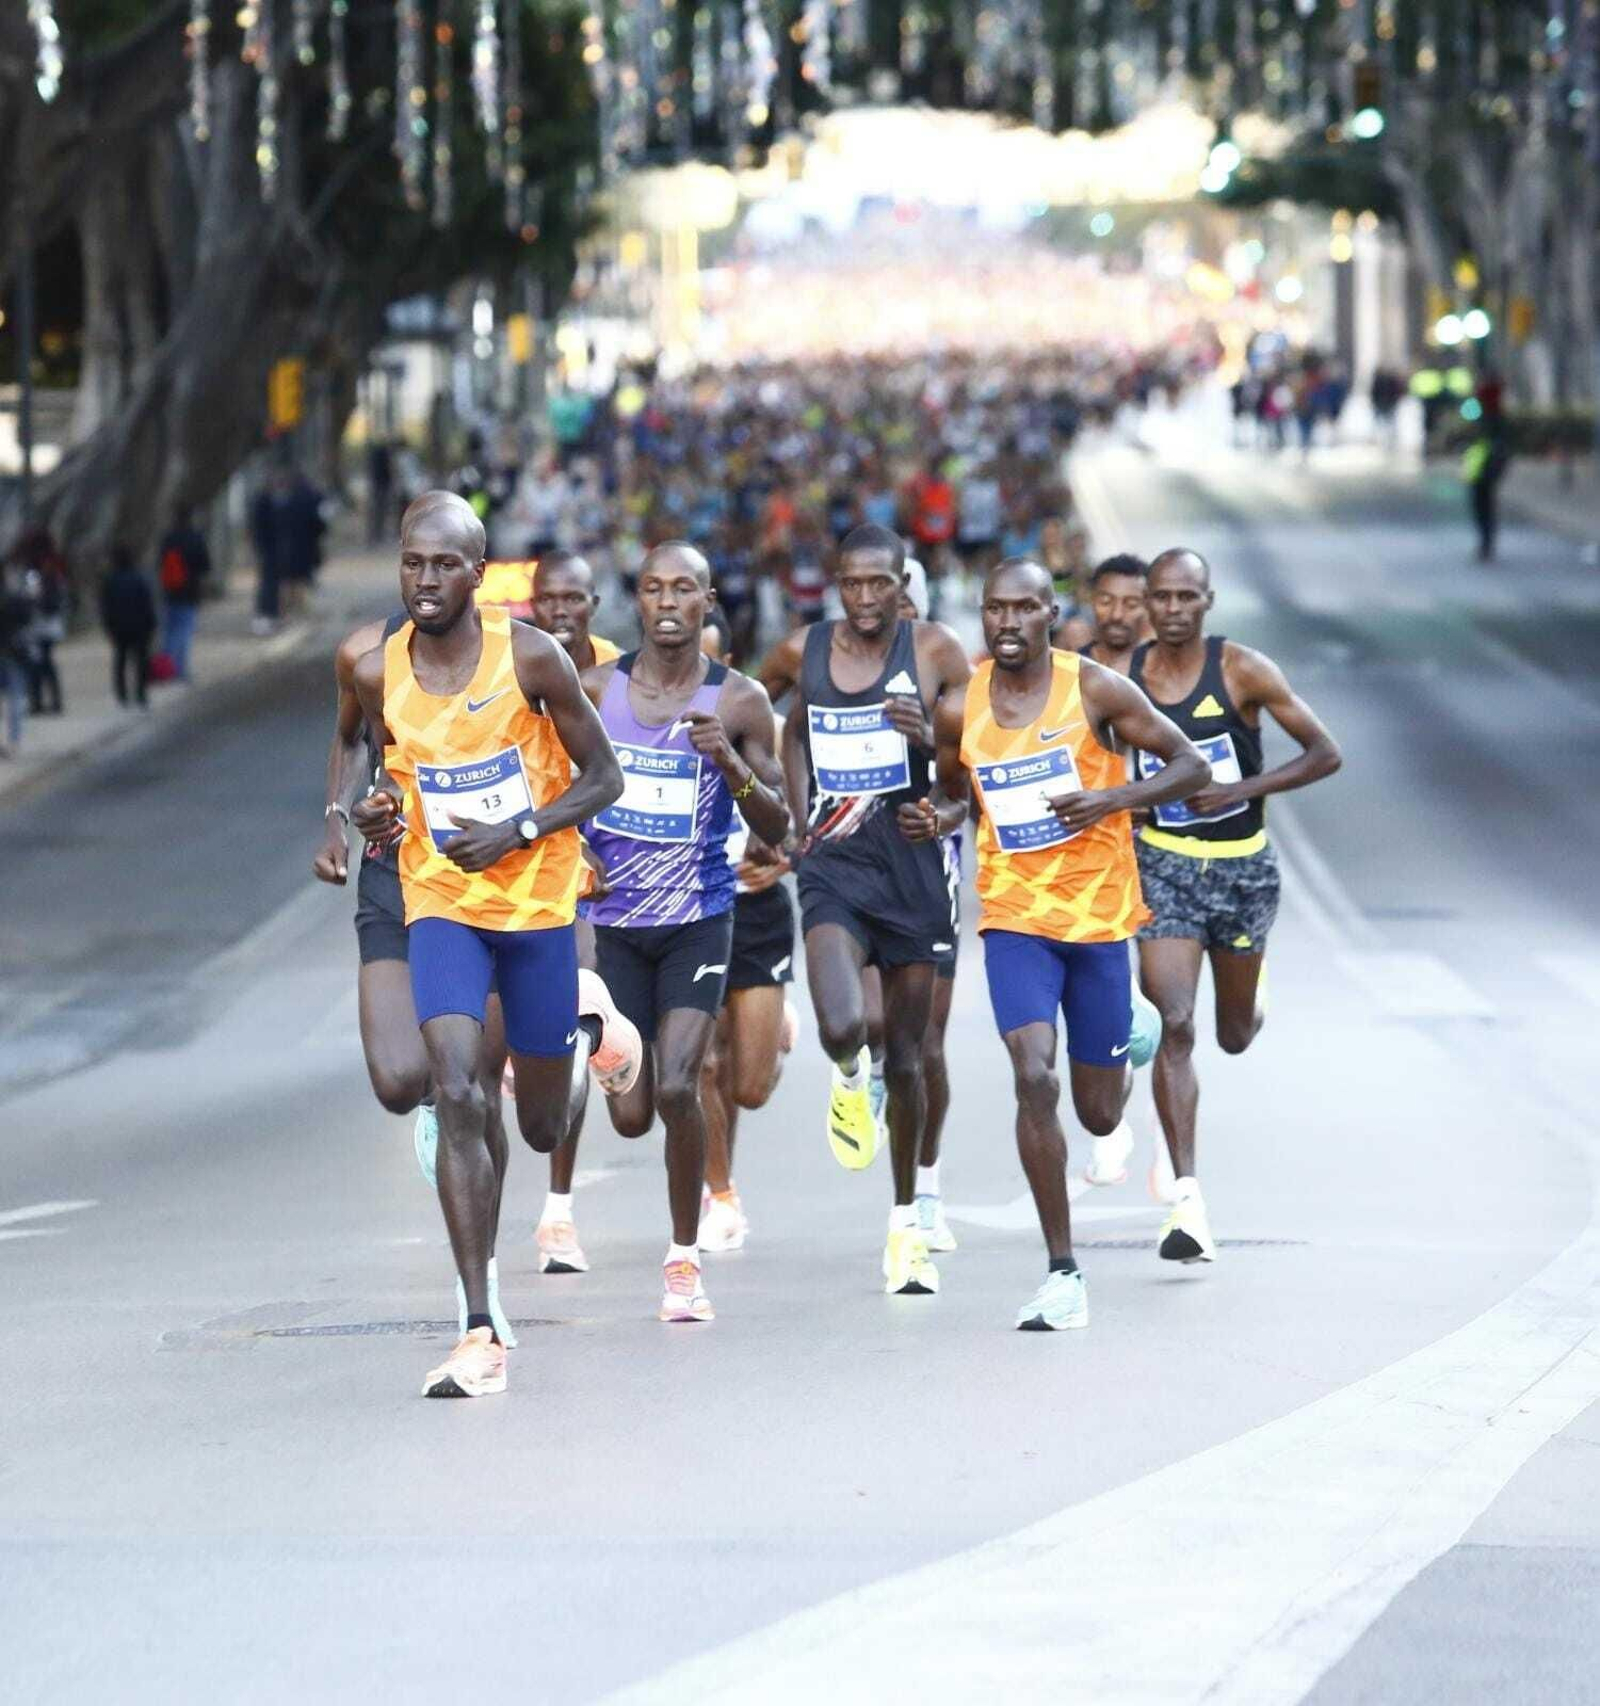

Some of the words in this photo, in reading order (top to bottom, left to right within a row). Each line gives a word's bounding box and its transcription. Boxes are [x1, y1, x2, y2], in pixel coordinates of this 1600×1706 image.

[636, 755, 678, 770] ZURICH
[1007, 760, 1051, 779] ZURICH
[454, 763, 501, 783] ZURICH
[656, 787, 663, 798] 1
[481, 794, 502, 810] 13
